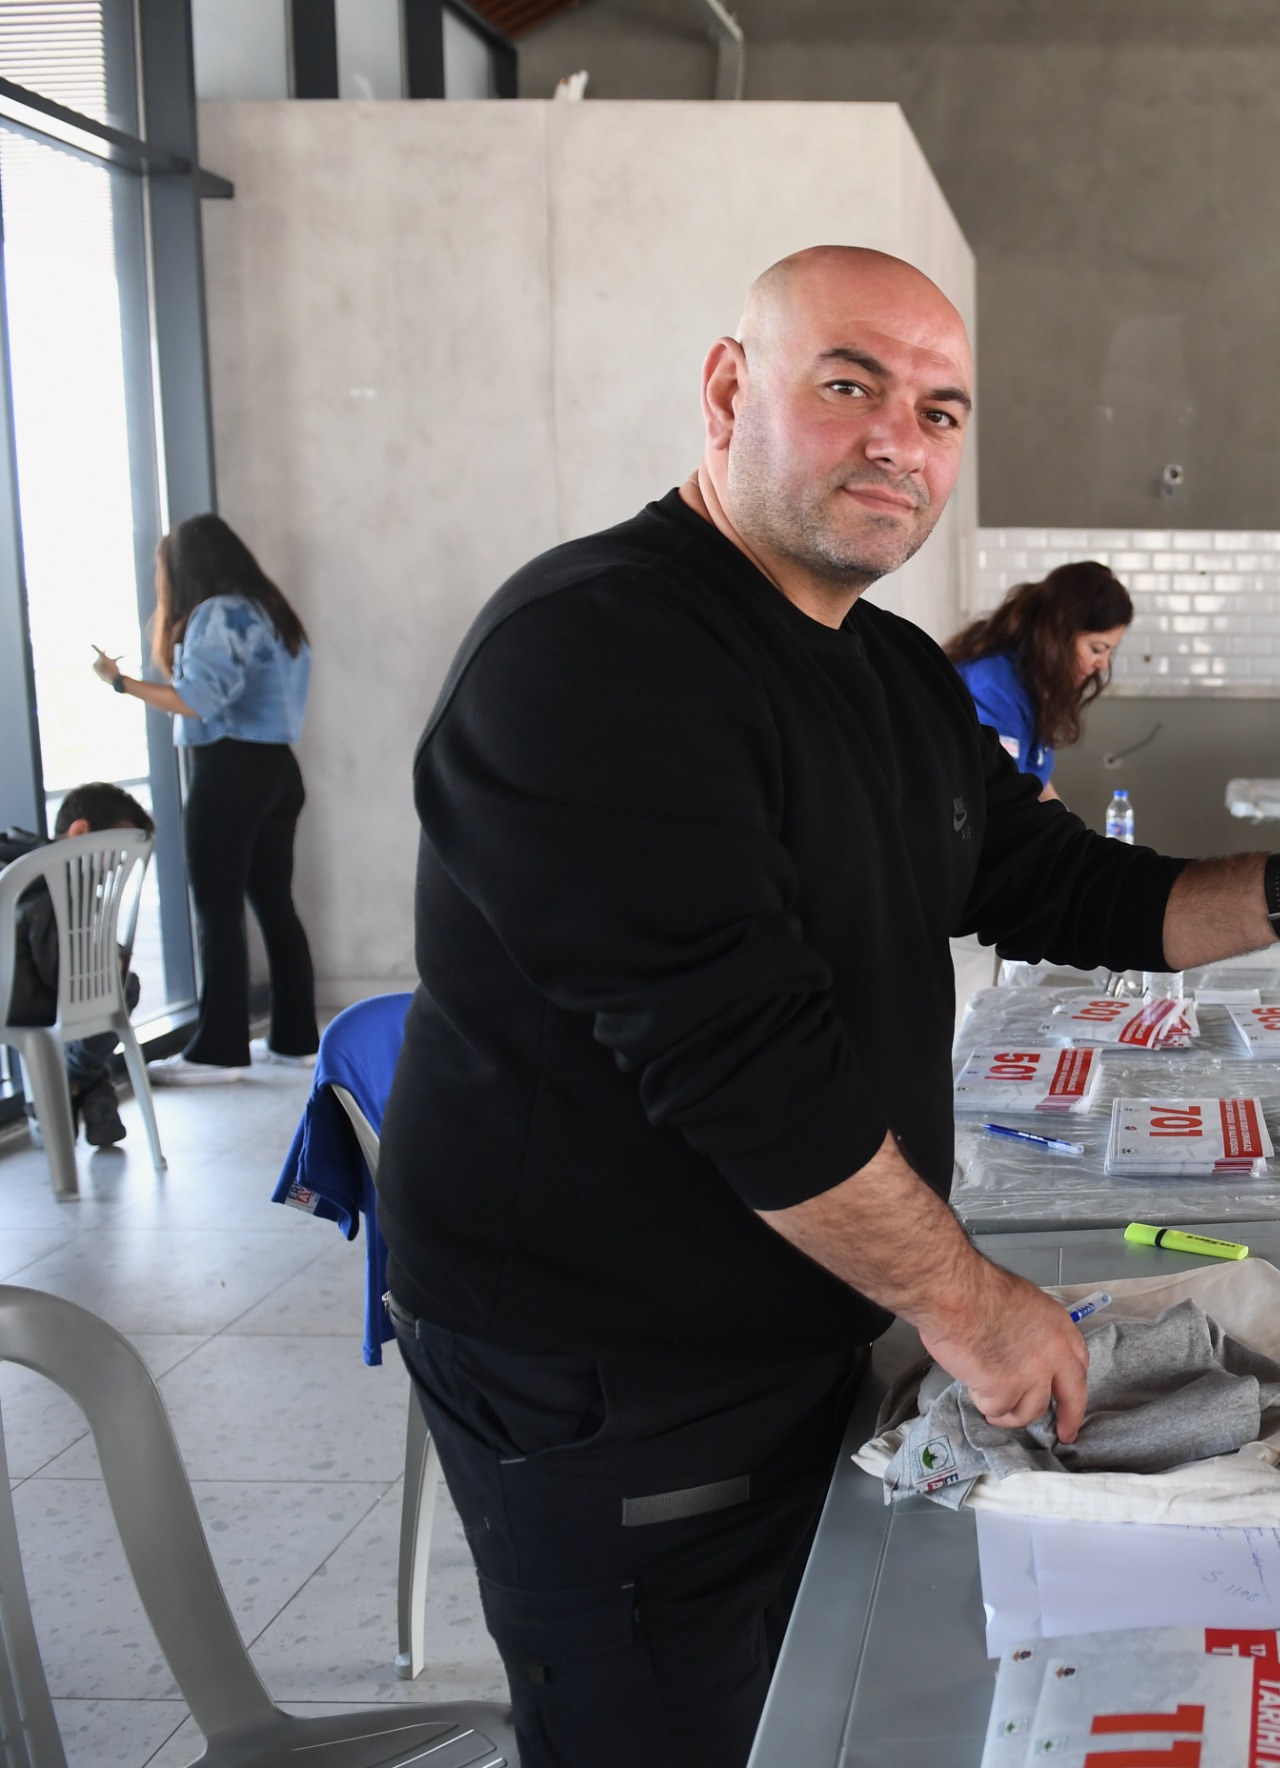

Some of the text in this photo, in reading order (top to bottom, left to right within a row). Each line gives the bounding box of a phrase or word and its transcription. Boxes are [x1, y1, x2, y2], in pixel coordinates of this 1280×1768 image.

[1071, 1001, 1130, 1022] 601
[984, 1052, 1041, 1081] 501
[1149, 1106, 1203, 1137] 701
